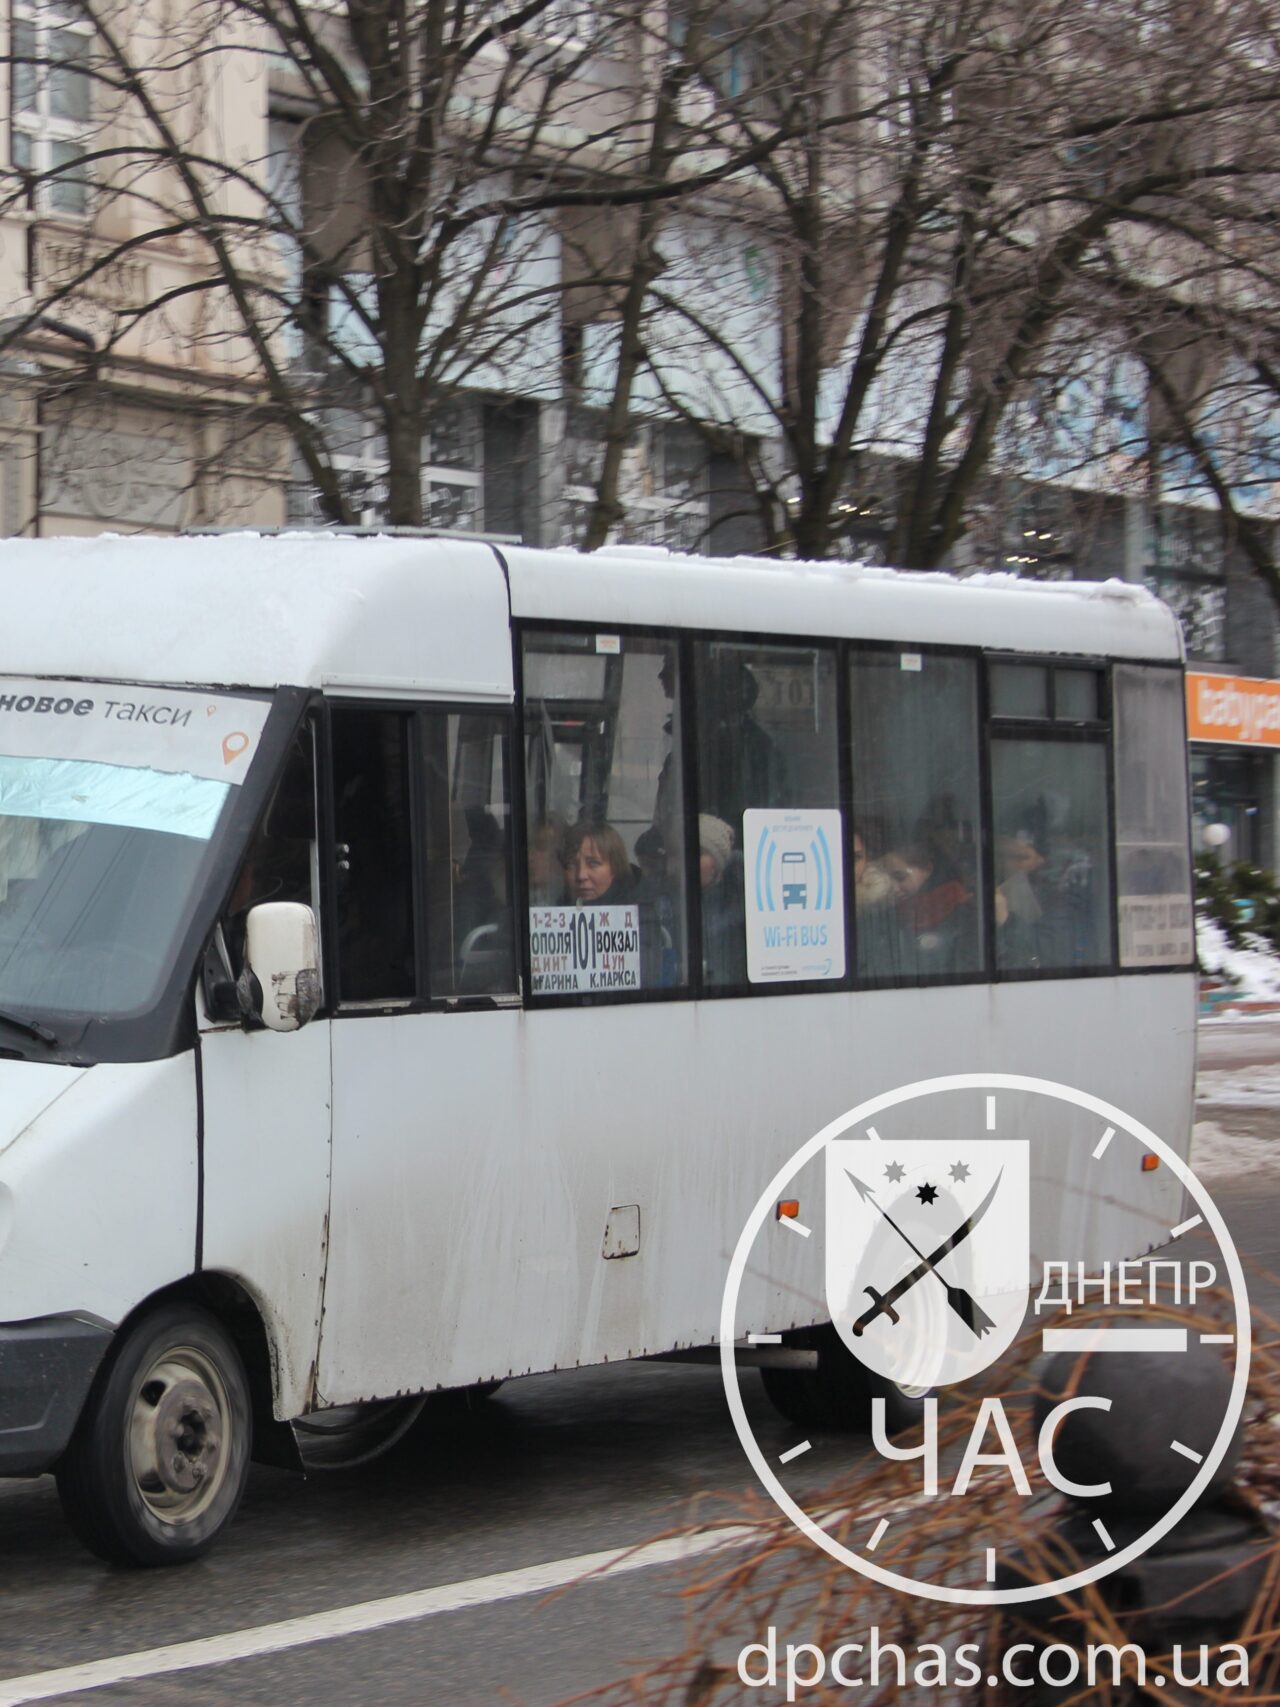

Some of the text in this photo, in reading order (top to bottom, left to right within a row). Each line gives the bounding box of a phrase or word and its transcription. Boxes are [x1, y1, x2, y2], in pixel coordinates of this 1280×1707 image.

[103, 699, 193, 728] такси
[569, 912, 597, 970] 101
[596, 930, 638, 953] ВОКЗАЛ
[801, 924, 828, 946] BUS
[602, 954, 625, 971] ЦУМ
